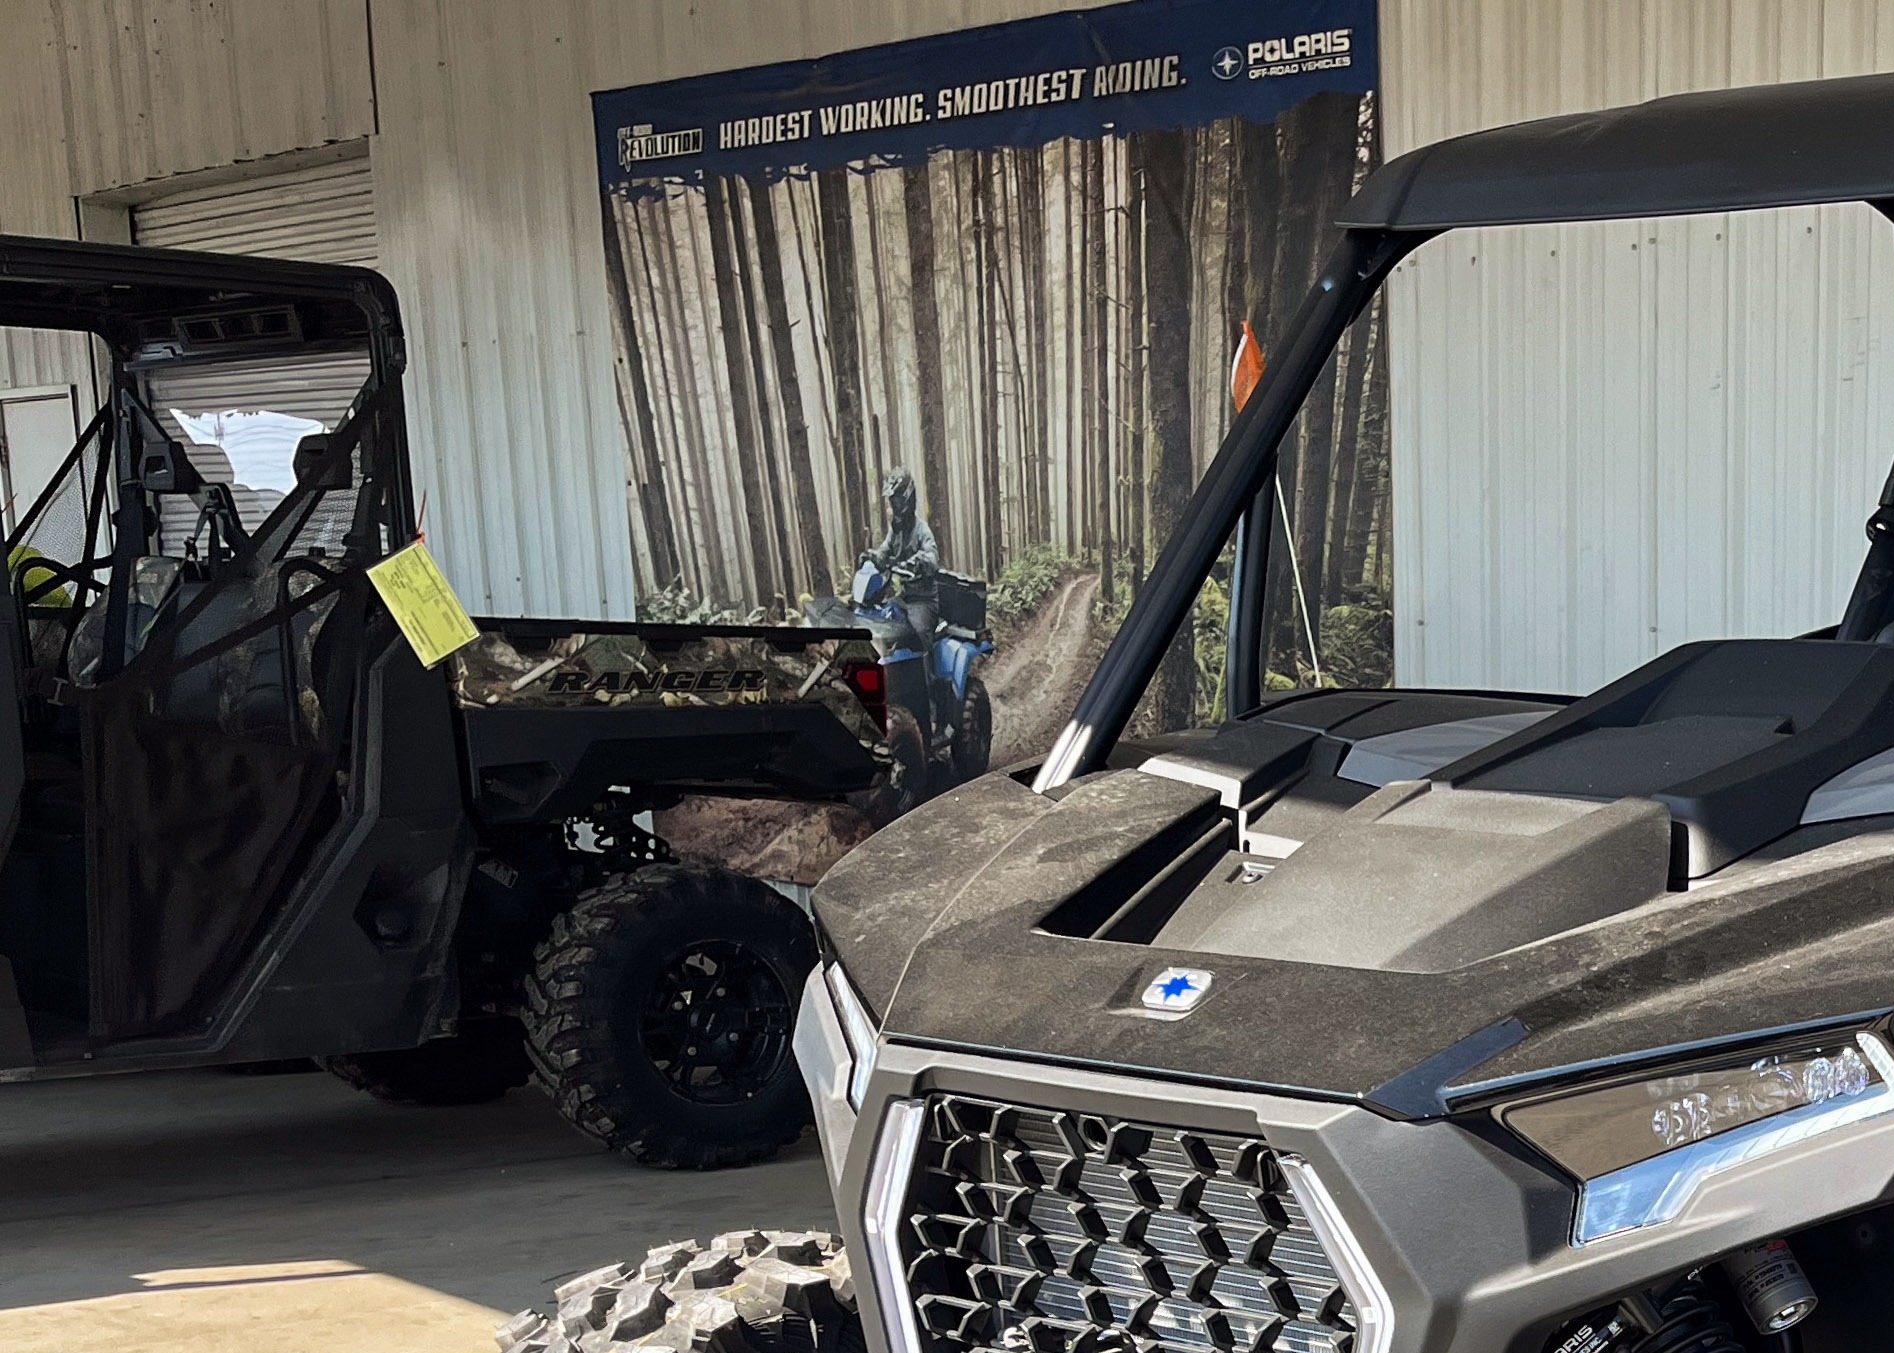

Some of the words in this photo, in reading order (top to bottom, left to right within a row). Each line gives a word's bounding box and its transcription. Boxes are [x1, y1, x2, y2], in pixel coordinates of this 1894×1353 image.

[1248, 28, 1350, 65] POLARIS
[1248, 61, 1299, 80] OFF-ROAD
[1300, 56, 1351, 73] VEHICLES
[719, 110, 813, 150] HARDEST
[819, 93, 932, 136] WORKING.
[937, 68, 1087, 119] SMOOTHEST
[618, 128, 703, 172] REVOLUTION
[548, 669, 767, 694] RANGER
